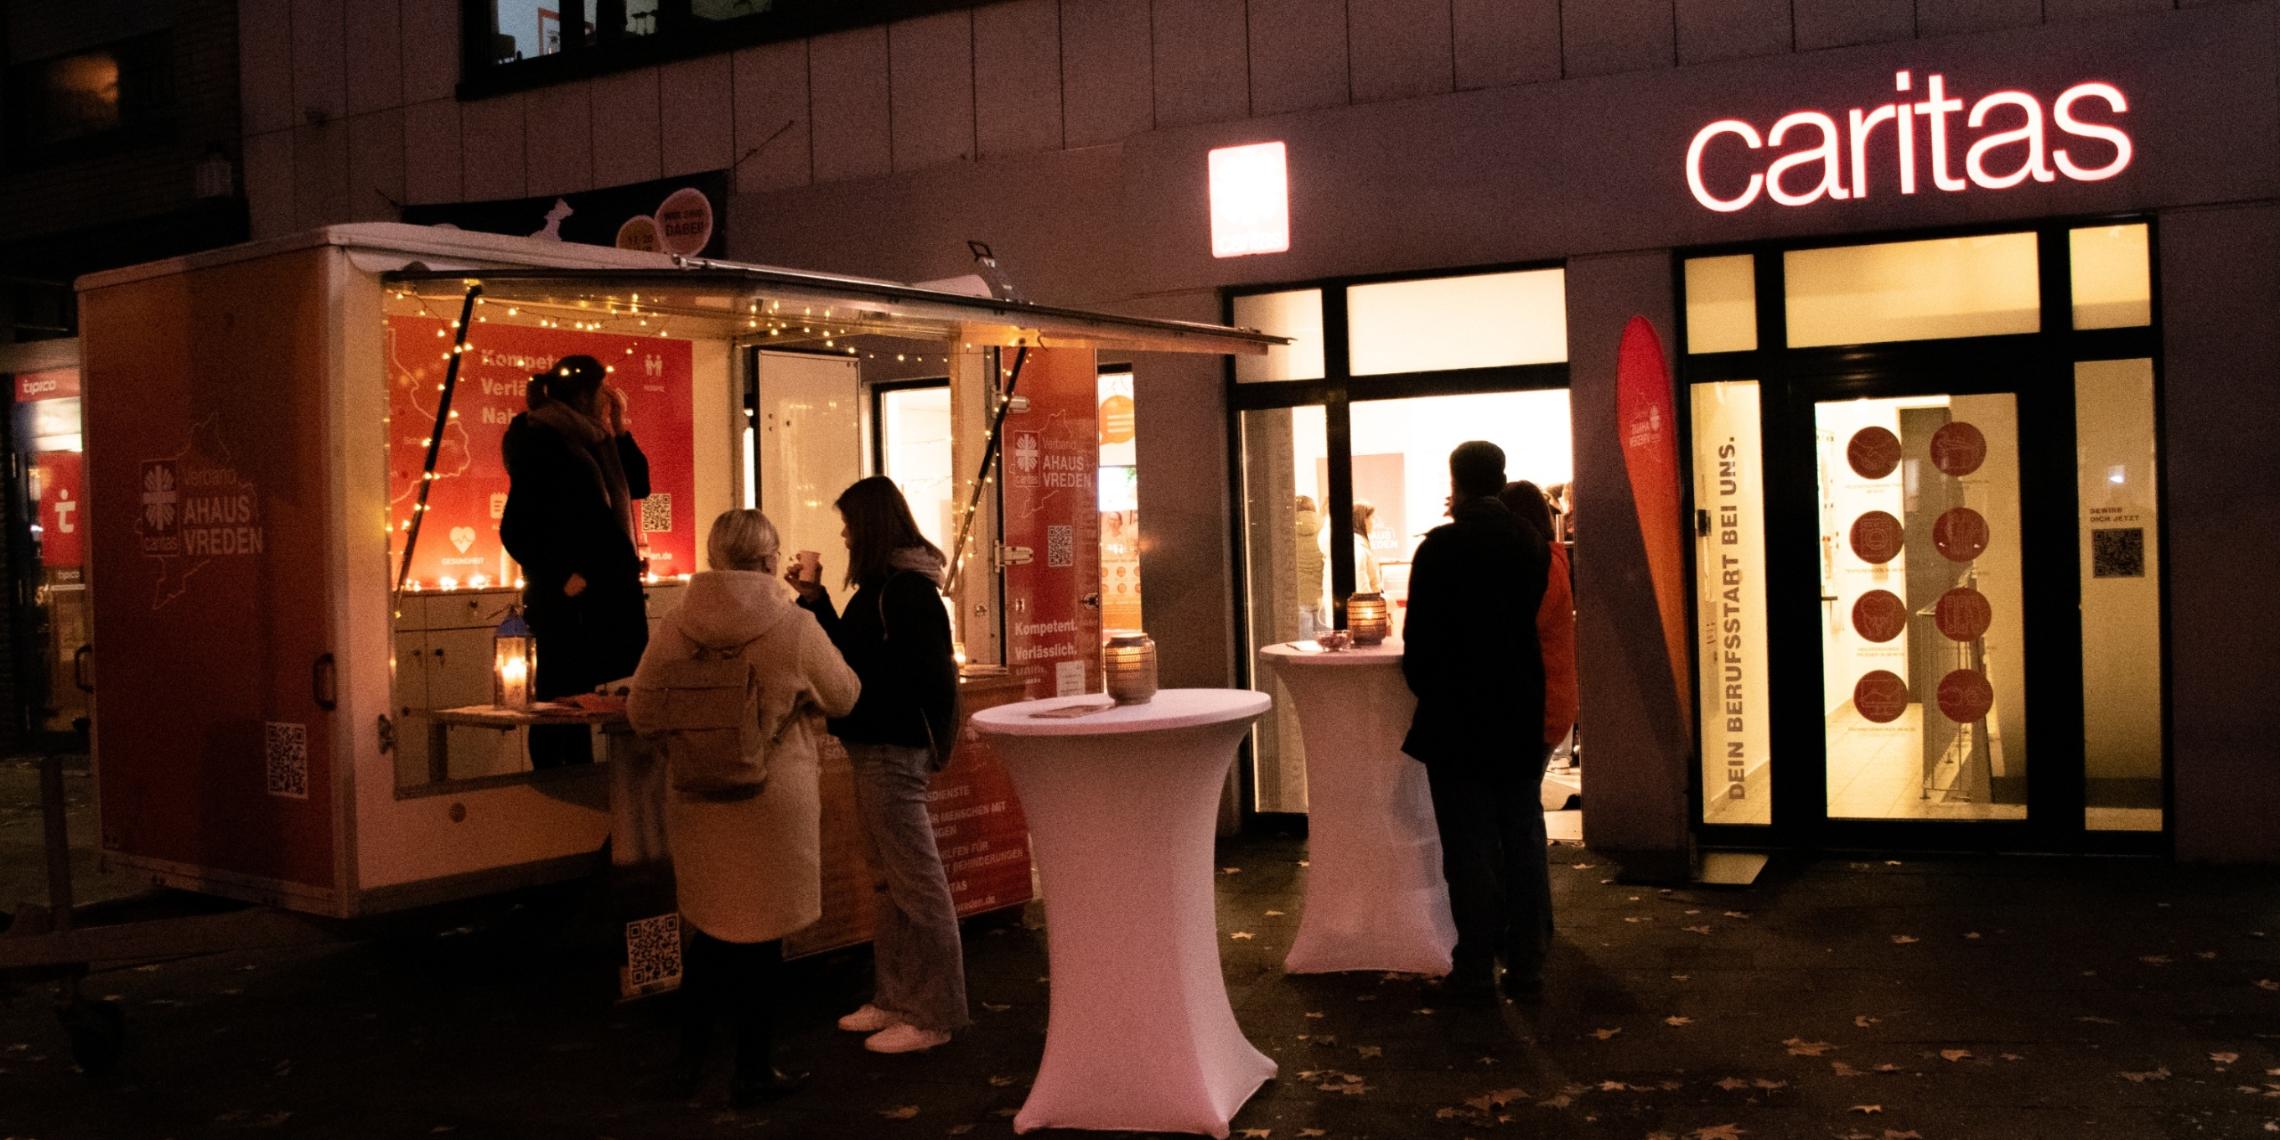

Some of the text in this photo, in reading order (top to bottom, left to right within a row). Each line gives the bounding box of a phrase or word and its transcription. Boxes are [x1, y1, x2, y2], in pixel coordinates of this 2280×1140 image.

[1685, 70, 2134, 213] caritas
[481, 348, 557, 371] Kompet
[22, 377, 57, 395] tipico
[480, 376, 528, 397] Verlä
[1043, 455, 1084, 471] AHAUS
[1043, 472, 1092, 488] VREDEN
[183, 495, 251, 524] AHAUS
[183, 527, 264, 555] VREDEN
[1015, 618, 1078, 637] Kompetent.
[1718, 436, 1747, 801] DEIN BERUFSSTART BEI UNS.
[1015, 641, 1078, 660] Verlässlich.
[926, 786, 969, 801] SDIENSTE
